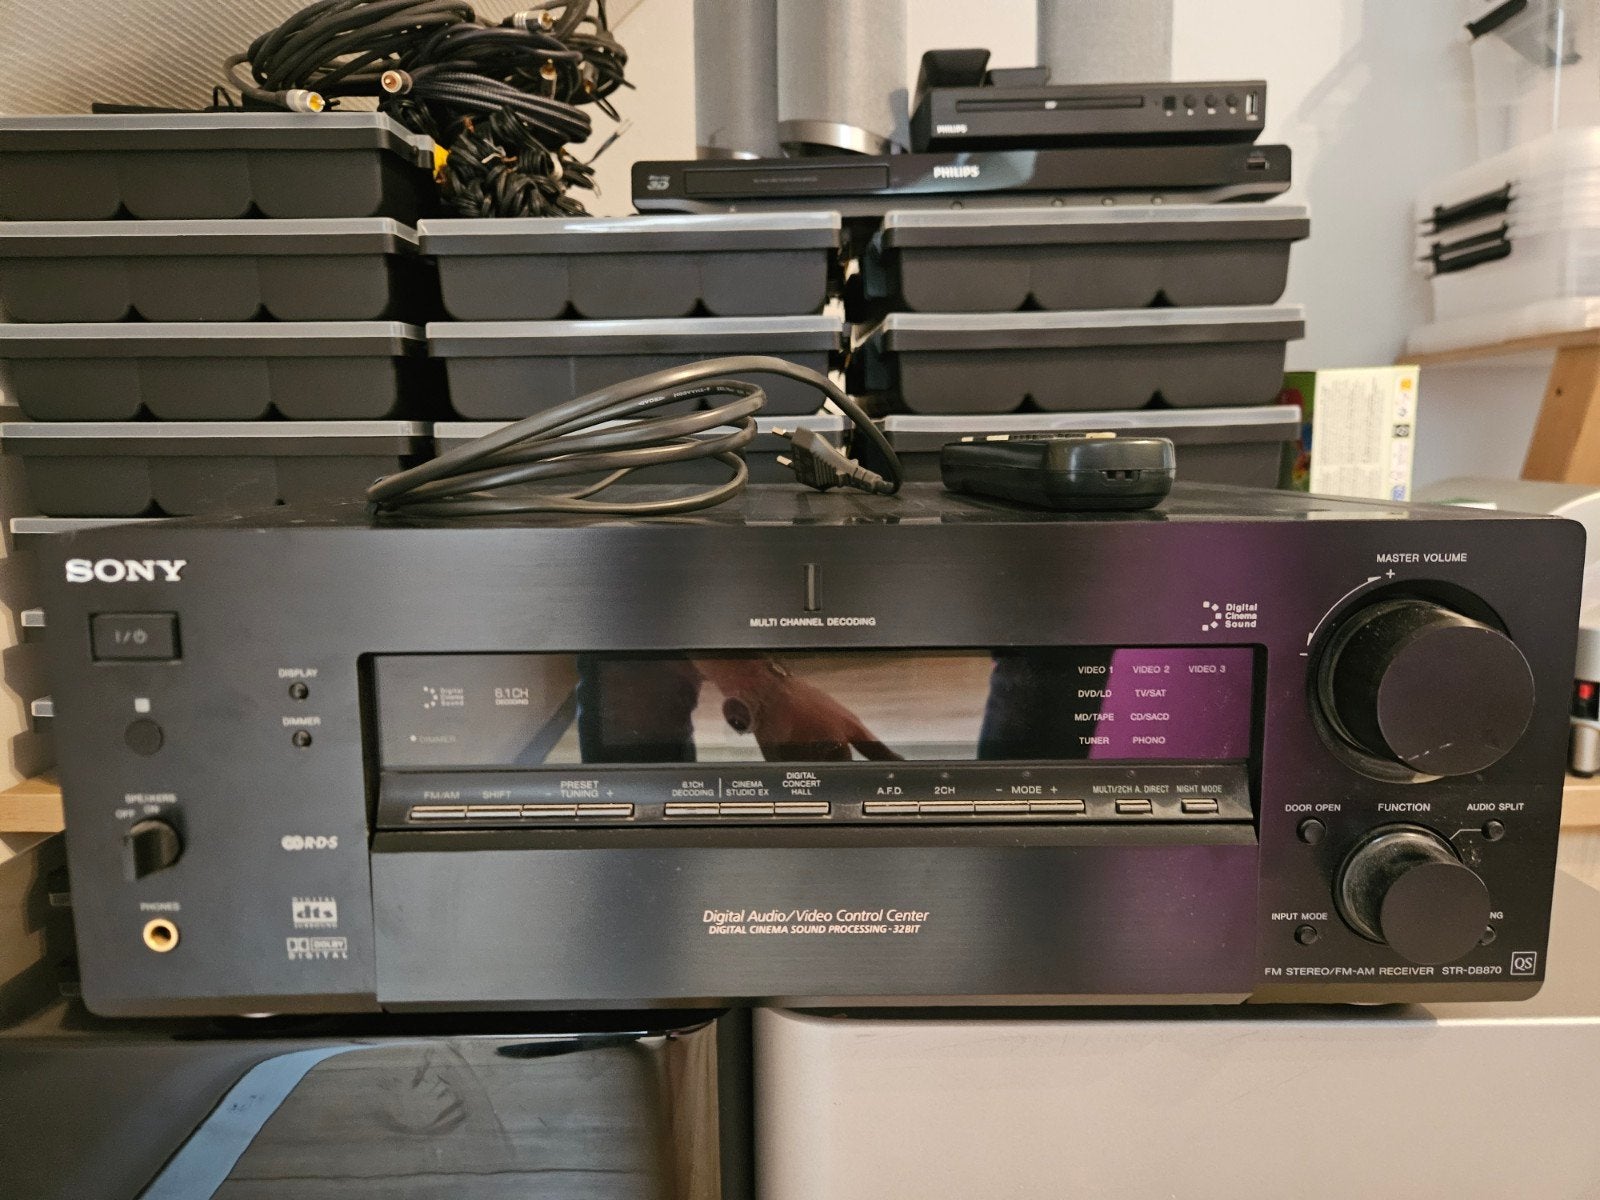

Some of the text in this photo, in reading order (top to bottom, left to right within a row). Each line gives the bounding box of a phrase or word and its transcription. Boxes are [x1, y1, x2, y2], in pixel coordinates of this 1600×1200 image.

[937, 124, 967, 133] PHILIPS
[933, 165, 980, 178] PHILIPS
[1376, 552, 1468, 563] MASTER VOLUME
[65, 559, 187, 583] SONY
[1225, 603, 1258, 612] Digital
[1225, 612, 1258, 620] Cinema
[749, 617, 877, 627] MULTI CHANNEL DECODING
[1225, 620, 1257, 628] Sound
[278, 668, 318, 678] DISPLAY
[1077, 665, 1114, 674] VIDEO 1
[1132, 665, 1170, 674] VIDEO 2
[1188, 664, 1226, 674] VIDEO 3
[1077, 689, 1112, 698] DVD/LD
[1135, 689, 1167, 697] TV/SAT
[1074, 713, 1115, 721] MD/TAPE
[1130, 712, 1170, 721] CD/SACD
[1079, 736, 1110, 745] TUNER
[1132, 736, 1166, 744] PHONO
[786, 772, 817, 780] DIGITAL
[560, 780, 599, 789] PRESET
[732, 780, 763, 788] CINEMA
[782, 780, 821, 788] CONCERT
[560, 789, 599, 798] TUNING
[671, 788, 715, 797] DECODING
[726, 788, 769, 797] STUDIO EX
[791, 788, 812, 796] HALL
[877, 787, 904, 795] A.F.D.
[934, 786, 955, 795] 2CH
[1011, 785, 1042, 795] MODE
[1092, 785, 1169, 794] MULTI/2CH A. DIRECT
[1176, 784, 1222, 794] NIGHT MODE
[423, 791, 460, 800] FM/AM
[482, 790, 512, 799] SHIFT
[1285, 804, 1341, 812] DOOR OPEN
[1377, 803, 1431, 812] FUNCTION
[1466, 802, 1525, 811] AUDIO SPLIT
[703, 908, 930, 925] Digital Audio/Video Control Center
[1271, 913, 1328, 921] INPUT MODE
[709, 925, 747, 934] DIGITAL
[749, 925, 789, 934] CINEMA
[790, 925, 826, 934] SOUND
[1514, 957, 1534, 970] QS
[1264, 966, 1503, 976] FM STEREO/FM-AM RECEIVER STR-DB870
